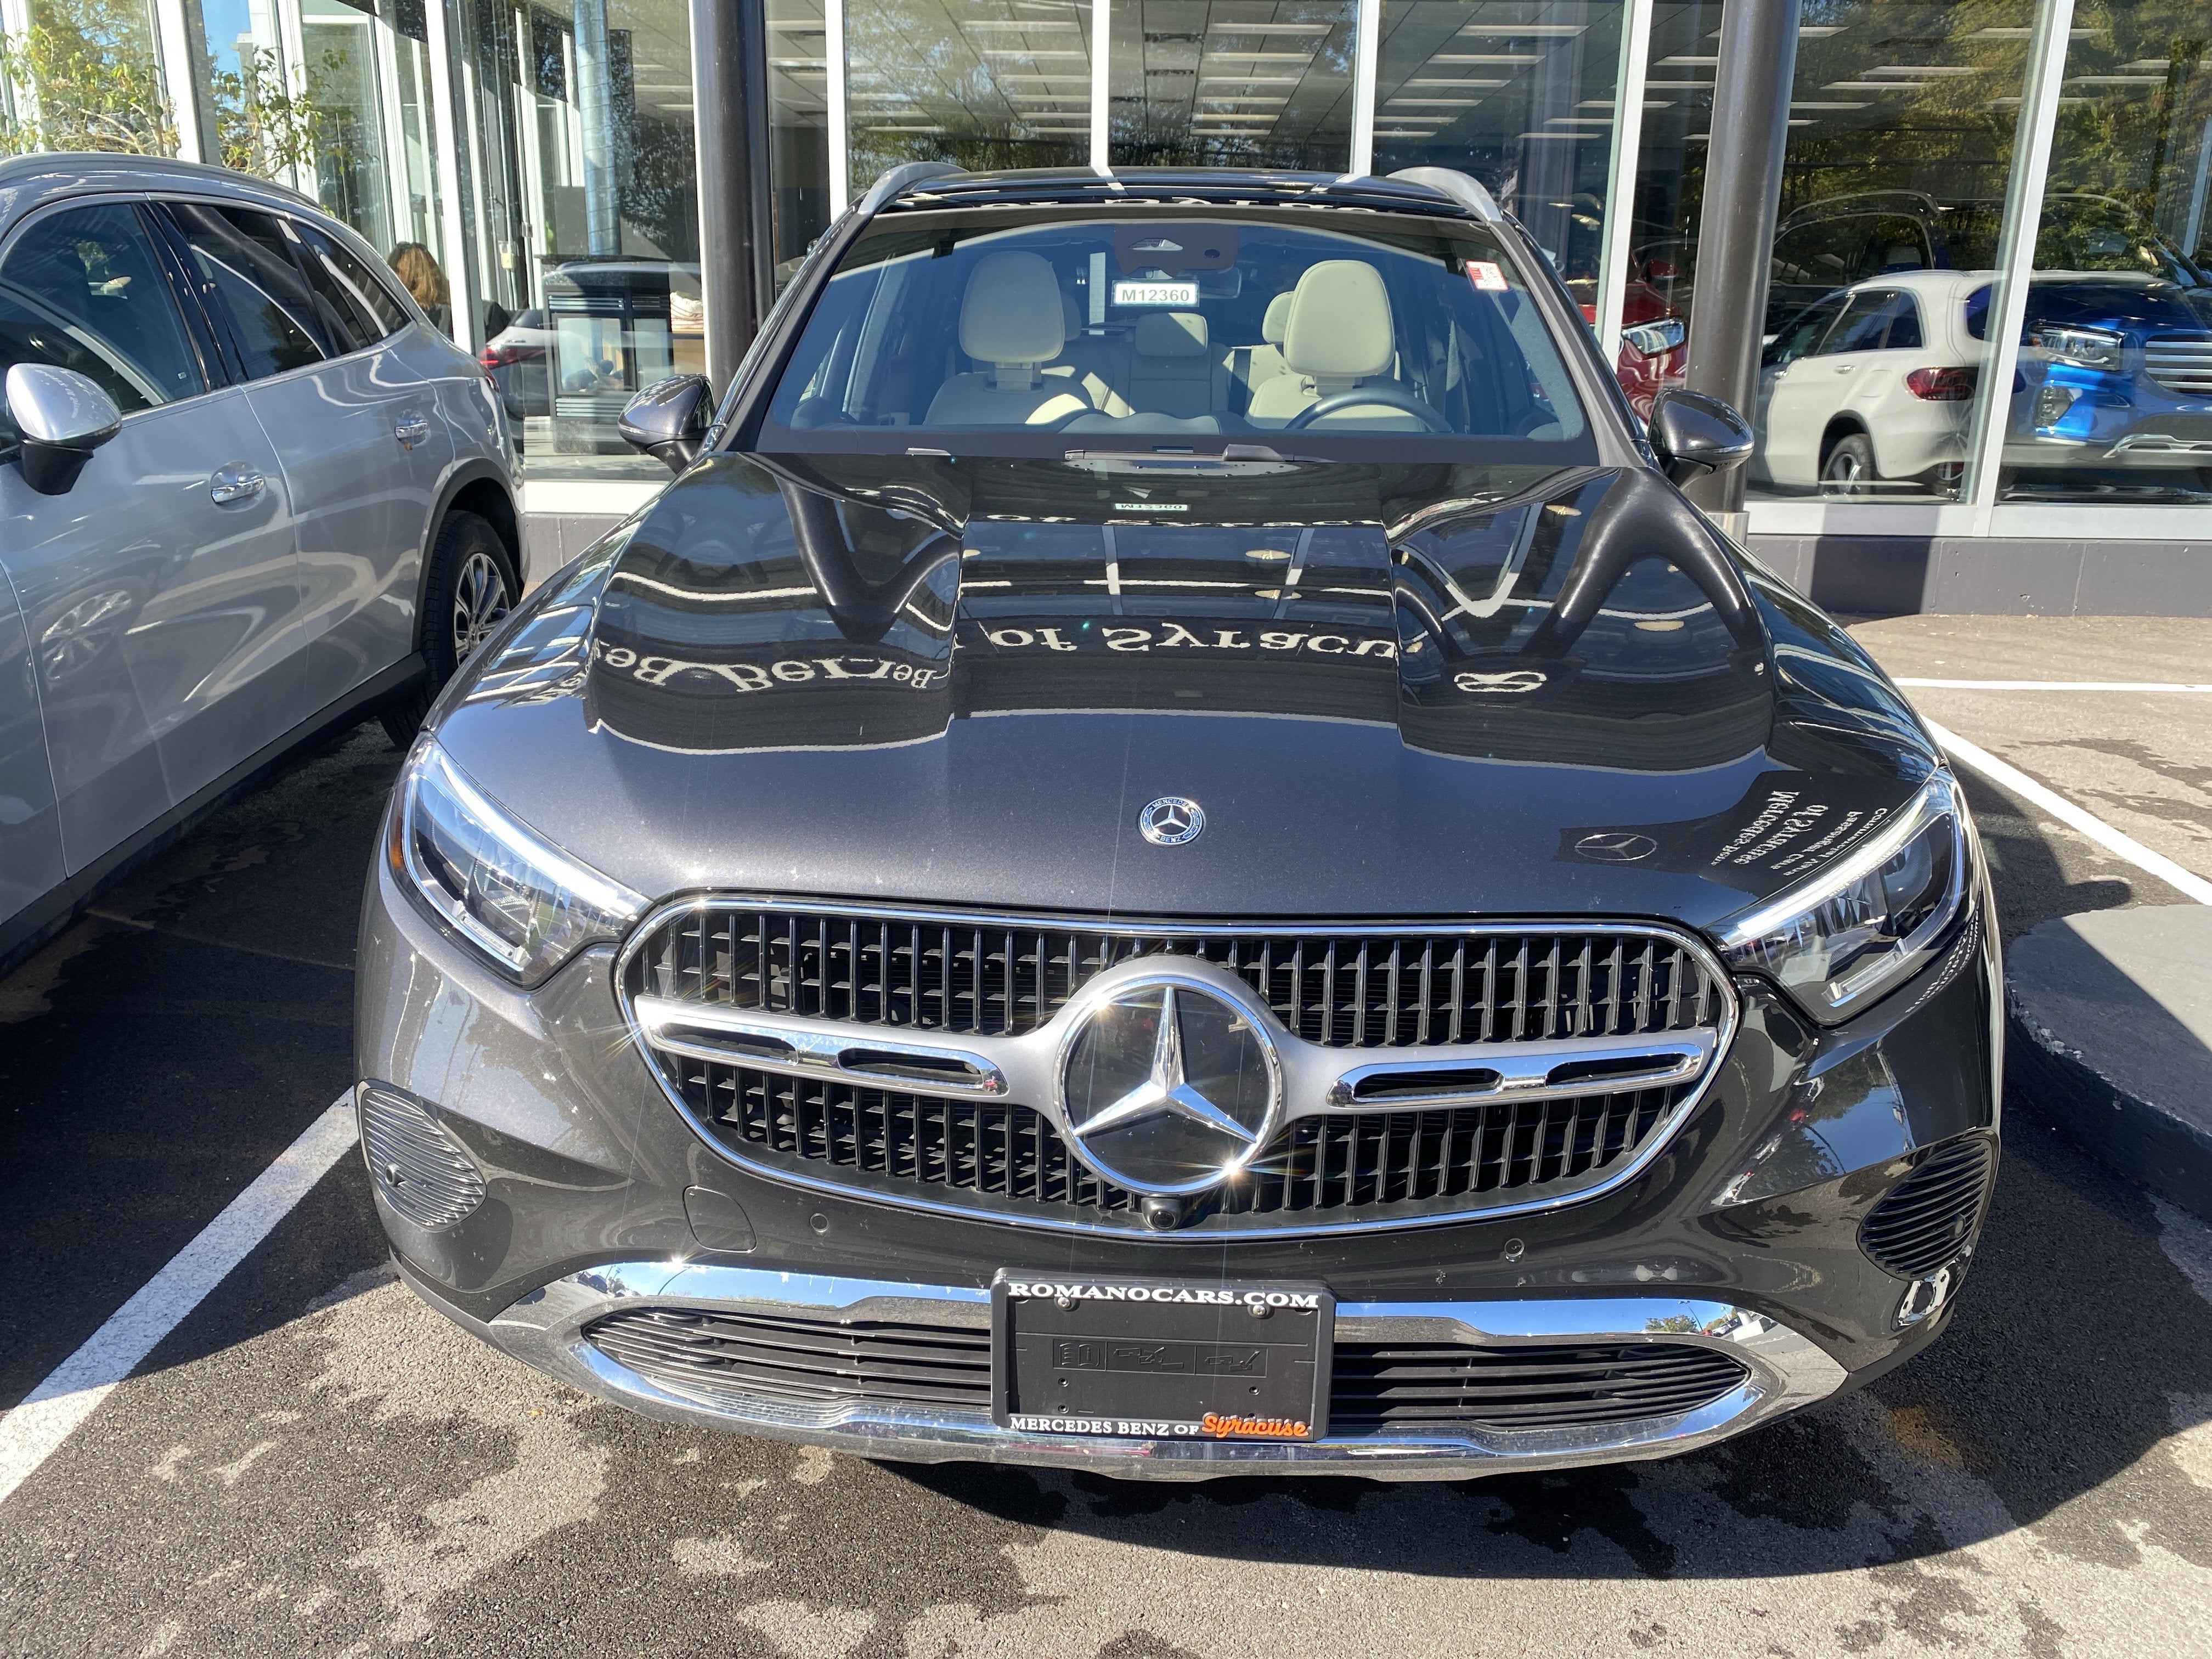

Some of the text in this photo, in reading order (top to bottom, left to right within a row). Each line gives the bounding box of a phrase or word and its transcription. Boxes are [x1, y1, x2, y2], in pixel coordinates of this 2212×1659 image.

[1122, 289, 1189, 302] M12360
[1159, 835, 1182, 843] BENZ
[1008, 1282, 1319, 1308] ROMANOCARS.COM
[1010, 1412, 1310, 1438] MERCEDES BENZ OF Syracuse
